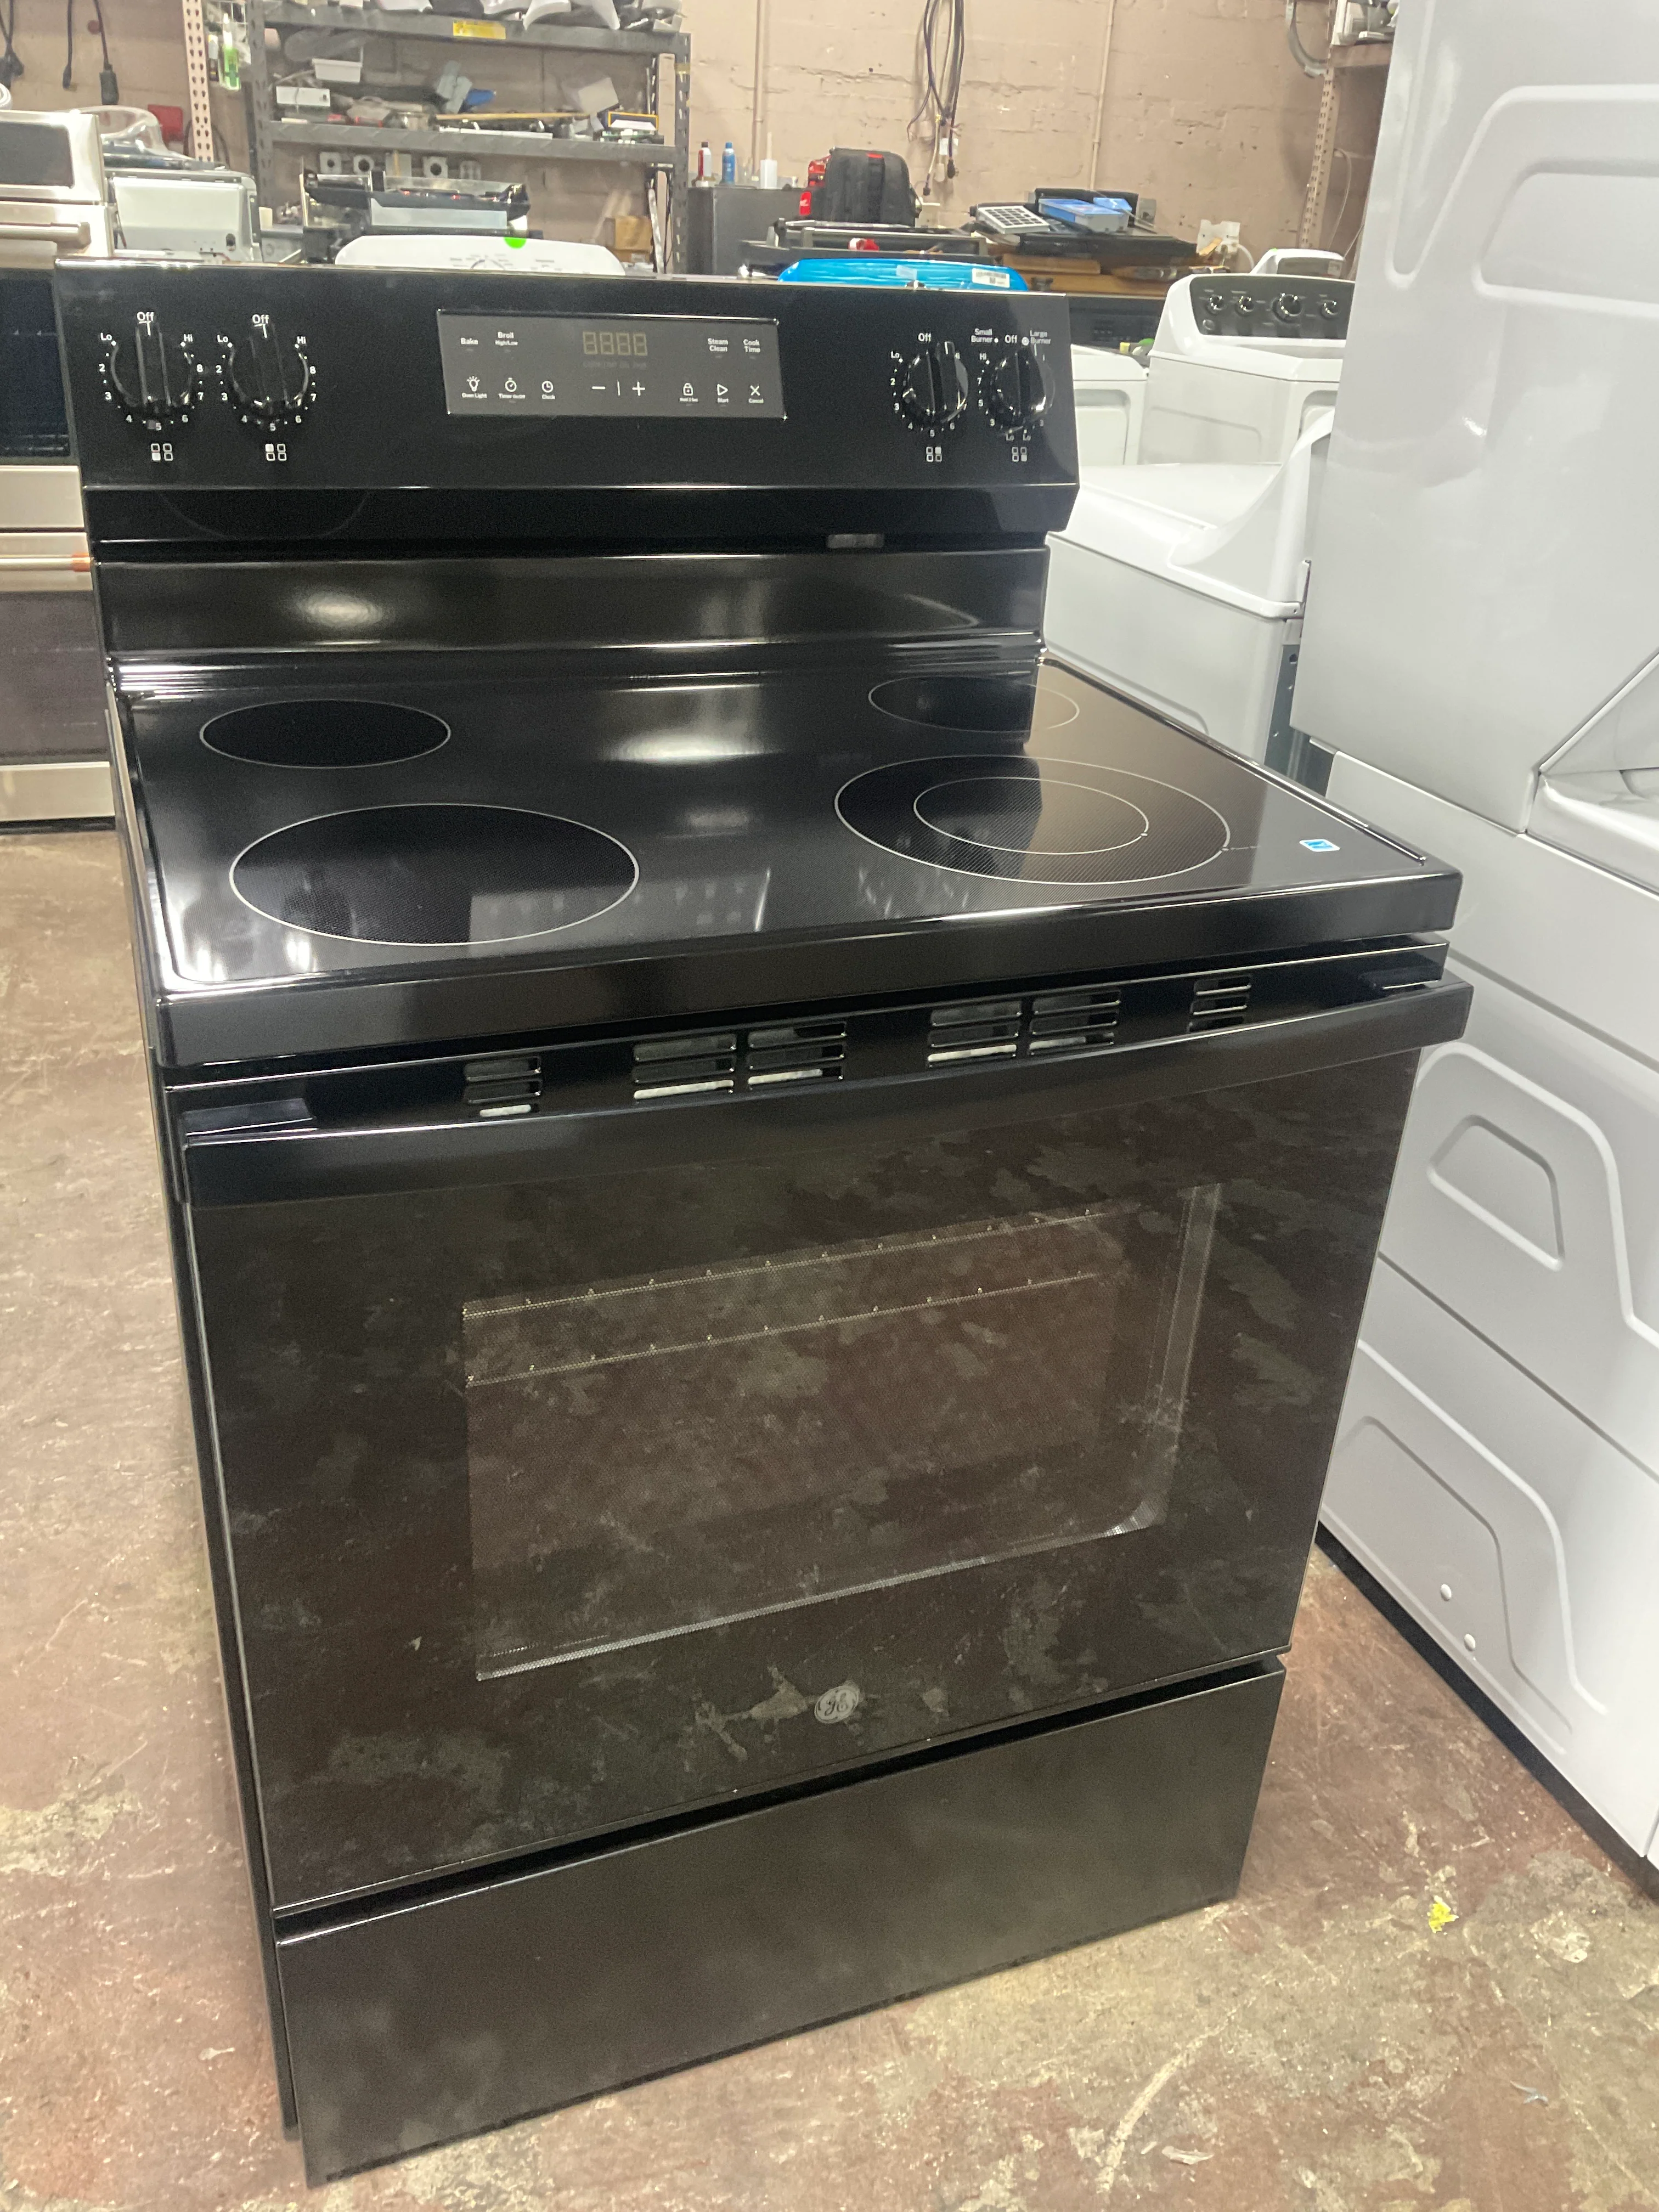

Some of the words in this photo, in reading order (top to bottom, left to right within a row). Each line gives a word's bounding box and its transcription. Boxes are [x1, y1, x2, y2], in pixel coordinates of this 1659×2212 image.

[137, 312, 154, 321] Off
[252, 314, 269, 324] Off
[100, 332, 112, 341] Lo
[183, 334, 193, 342] Hi
[217, 335, 229, 343] Lo
[297, 336, 306, 345] Hi
[918, 332, 932, 342] Off
[1005, 334, 1018, 343] Off
[99, 364, 106, 372] 2
[196, 364, 204, 373] 8
[216, 365, 222, 373] 2
[309, 365, 317, 374] 8
[105, 392, 112, 400] 3
[198, 392, 204, 400] 7
[222, 392, 228, 401] 3
[311, 393, 317, 402] 7
[182, 415, 189, 423] 6
[295, 415, 302, 423] 6
[156, 422, 162, 431] 5
[269, 423, 276, 432] 5
